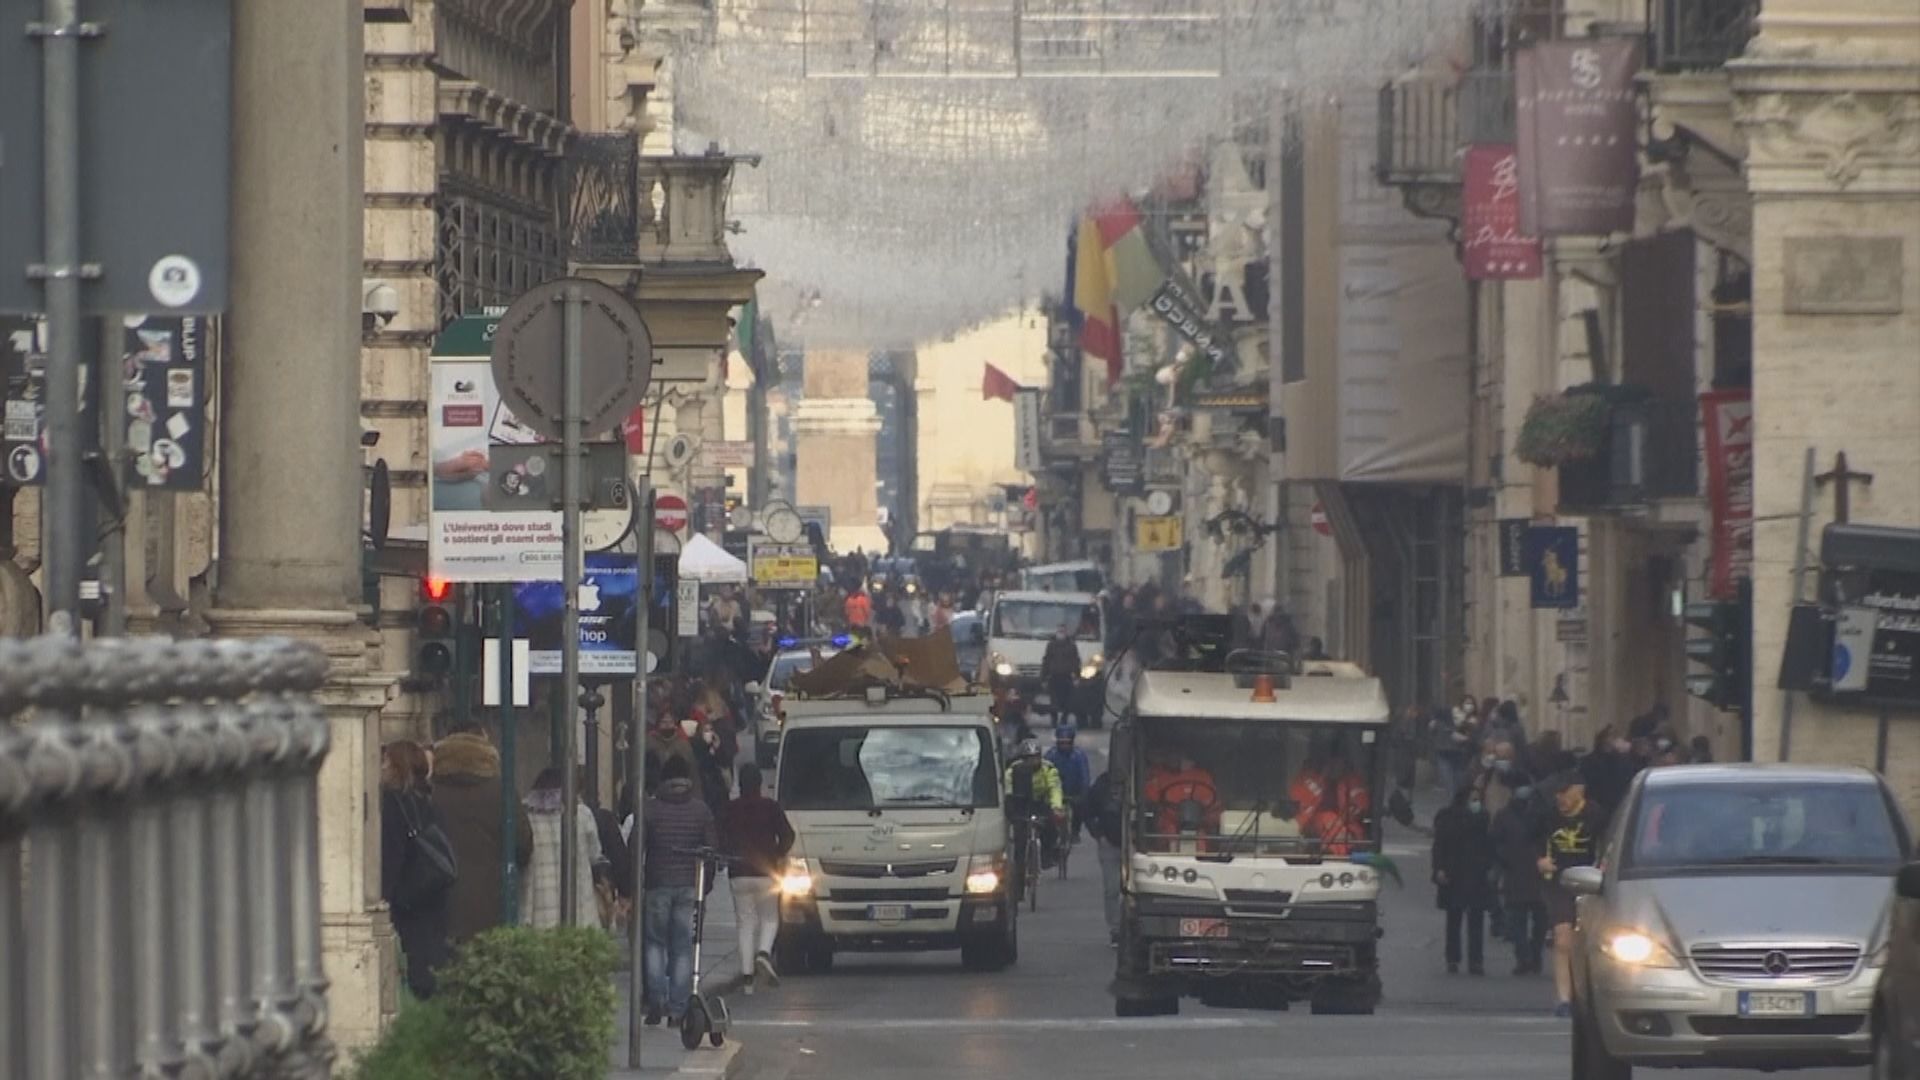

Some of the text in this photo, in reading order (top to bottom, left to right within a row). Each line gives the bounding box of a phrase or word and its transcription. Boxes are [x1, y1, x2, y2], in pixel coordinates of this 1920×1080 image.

[443, 521, 552, 533] L'Università dove studi
[451, 534, 489, 543] sostieni
[506, 534, 534, 543] esami
[536, 534, 563, 543] onlin
[580, 628, 607, 643] hop
